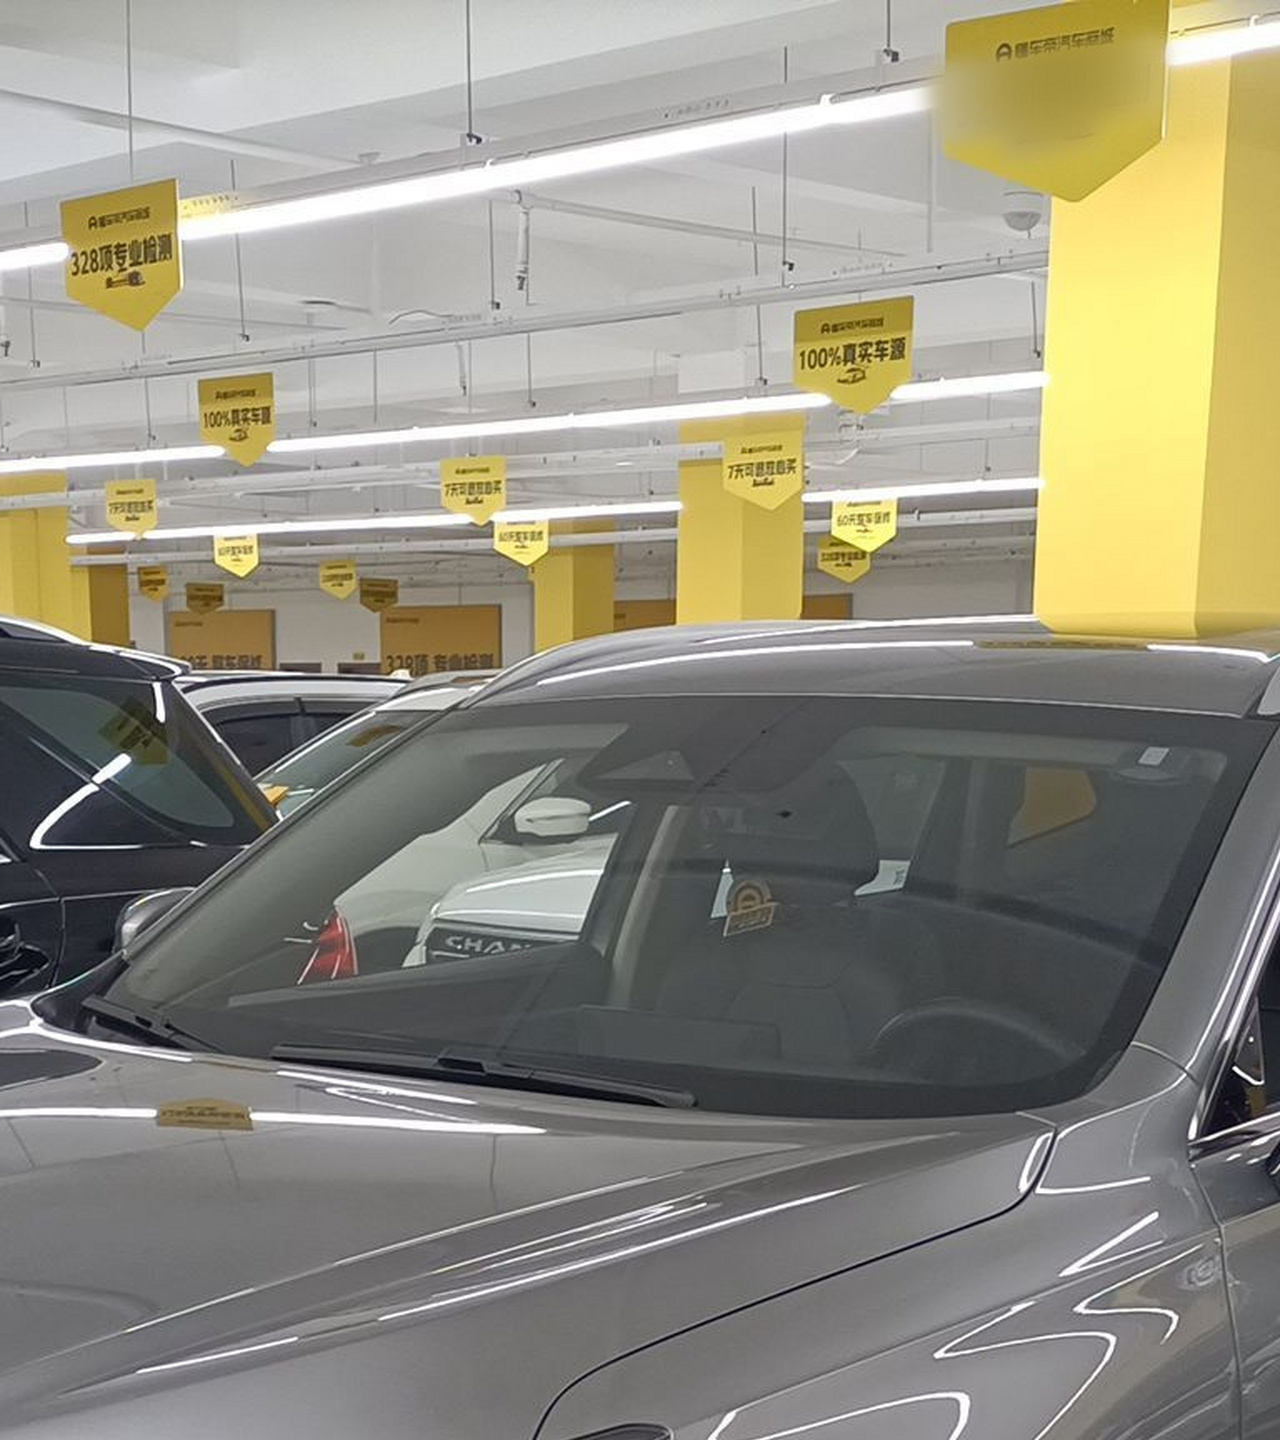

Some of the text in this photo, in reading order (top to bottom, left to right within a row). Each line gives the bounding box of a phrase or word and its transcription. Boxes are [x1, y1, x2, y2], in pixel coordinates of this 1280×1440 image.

[70, 233, 173, 277] 328项专业检测
[799, 336, 906, 370] 100%真实车源
